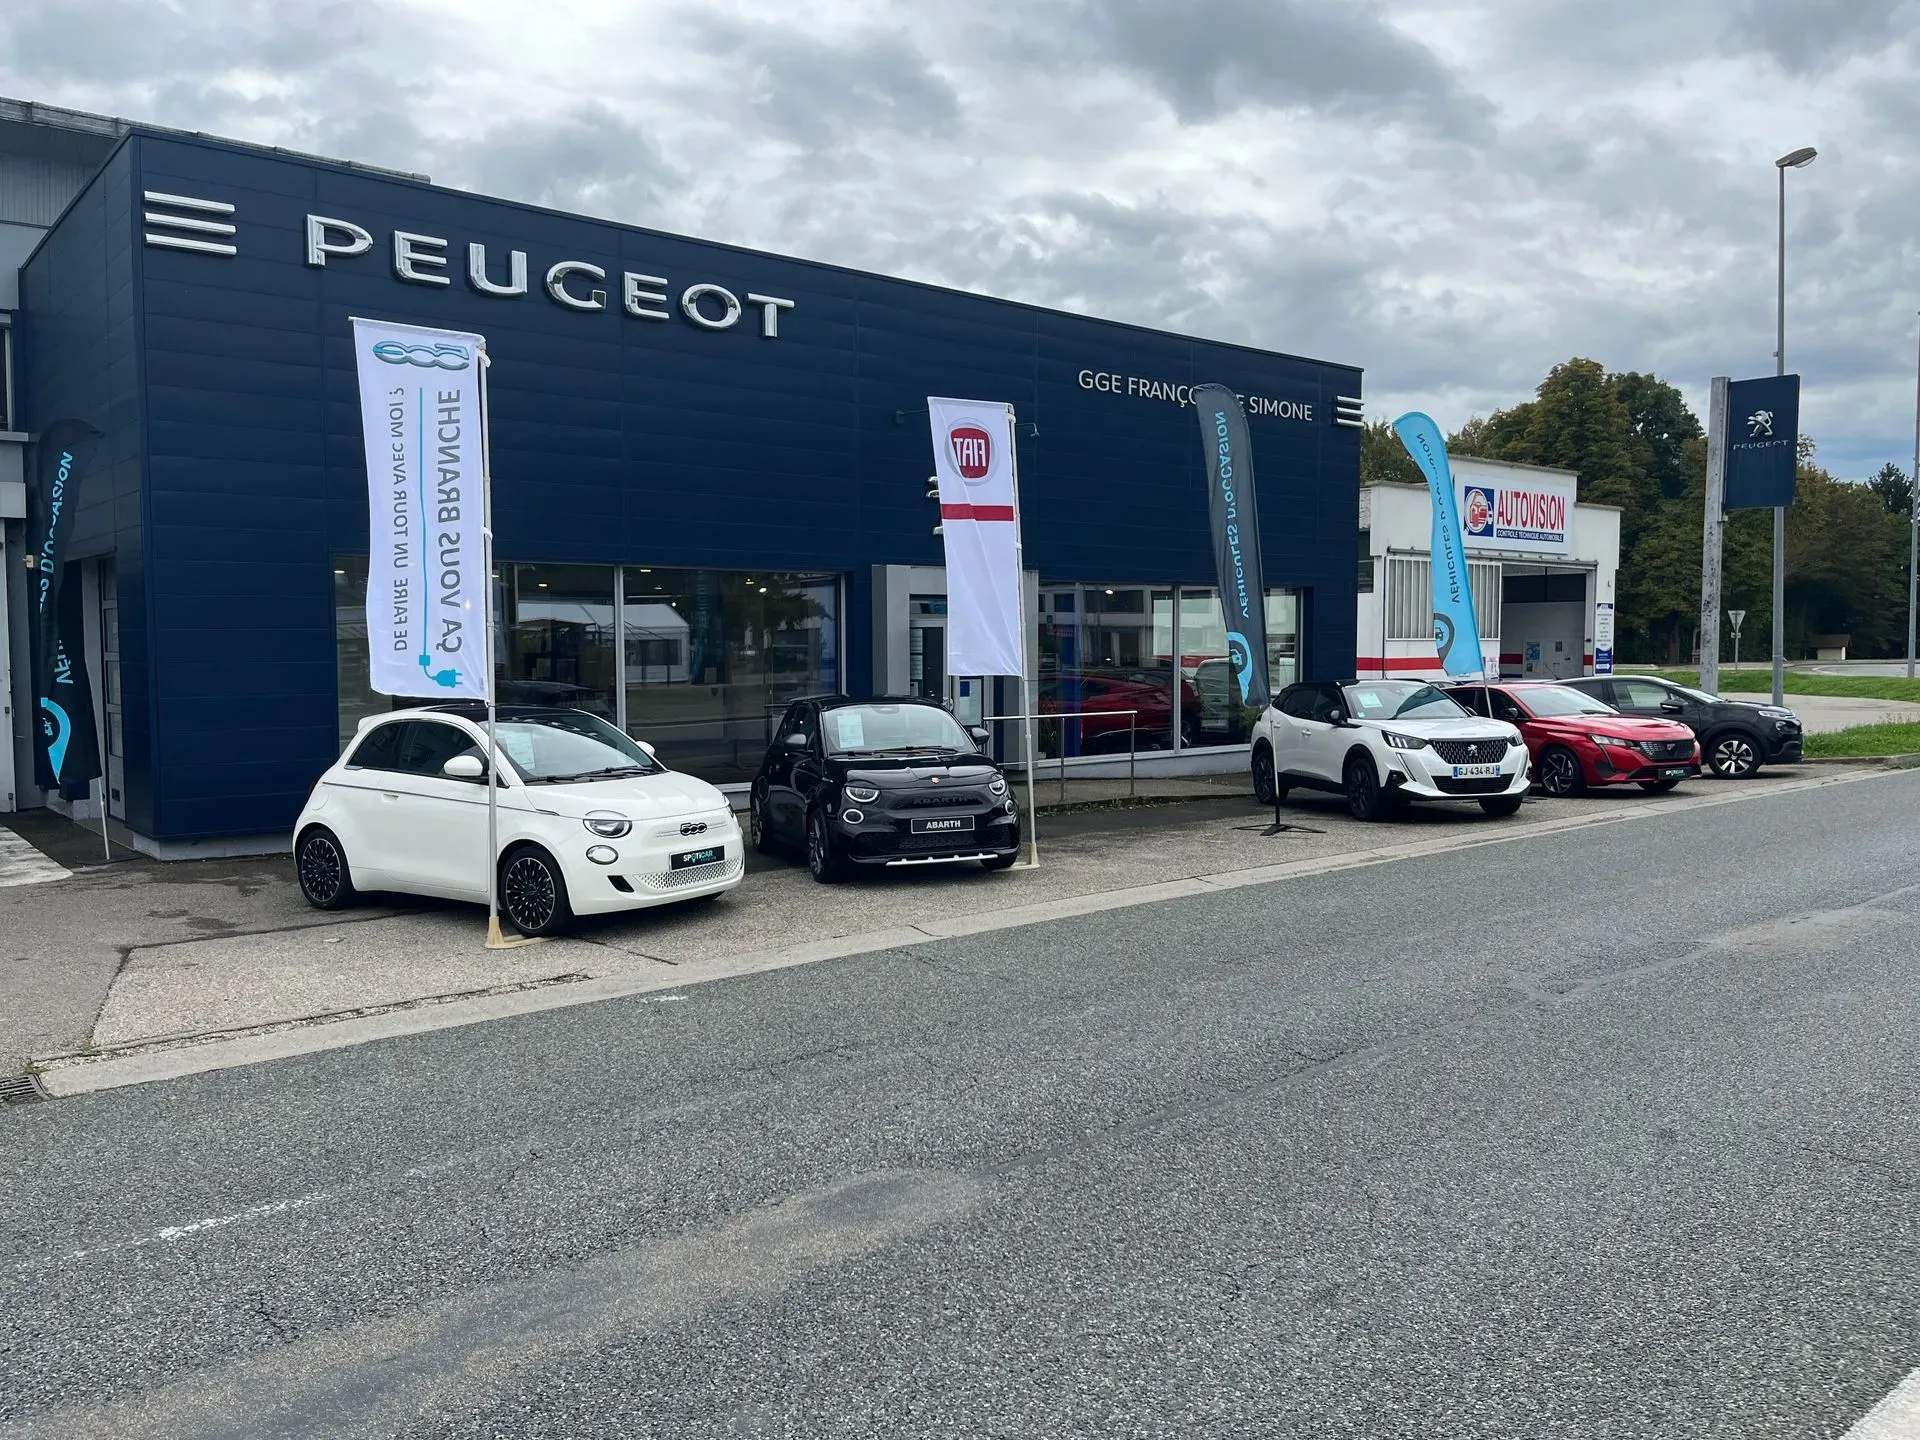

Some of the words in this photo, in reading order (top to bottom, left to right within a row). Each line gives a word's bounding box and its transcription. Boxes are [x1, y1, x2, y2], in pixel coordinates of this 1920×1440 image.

[306, 213, 796, 338] PEUGEOT
[1078, 369, 1122, 394] GGE
[1128, 377, 1197, 408] FRANÇ
[1249, 396, 1313, 421] SIMONE
[1497, 490, 1565, 530] AUTOVISION
[680, 823, 707, 836] 500
[926, 820, 961, 829] ABARTH
